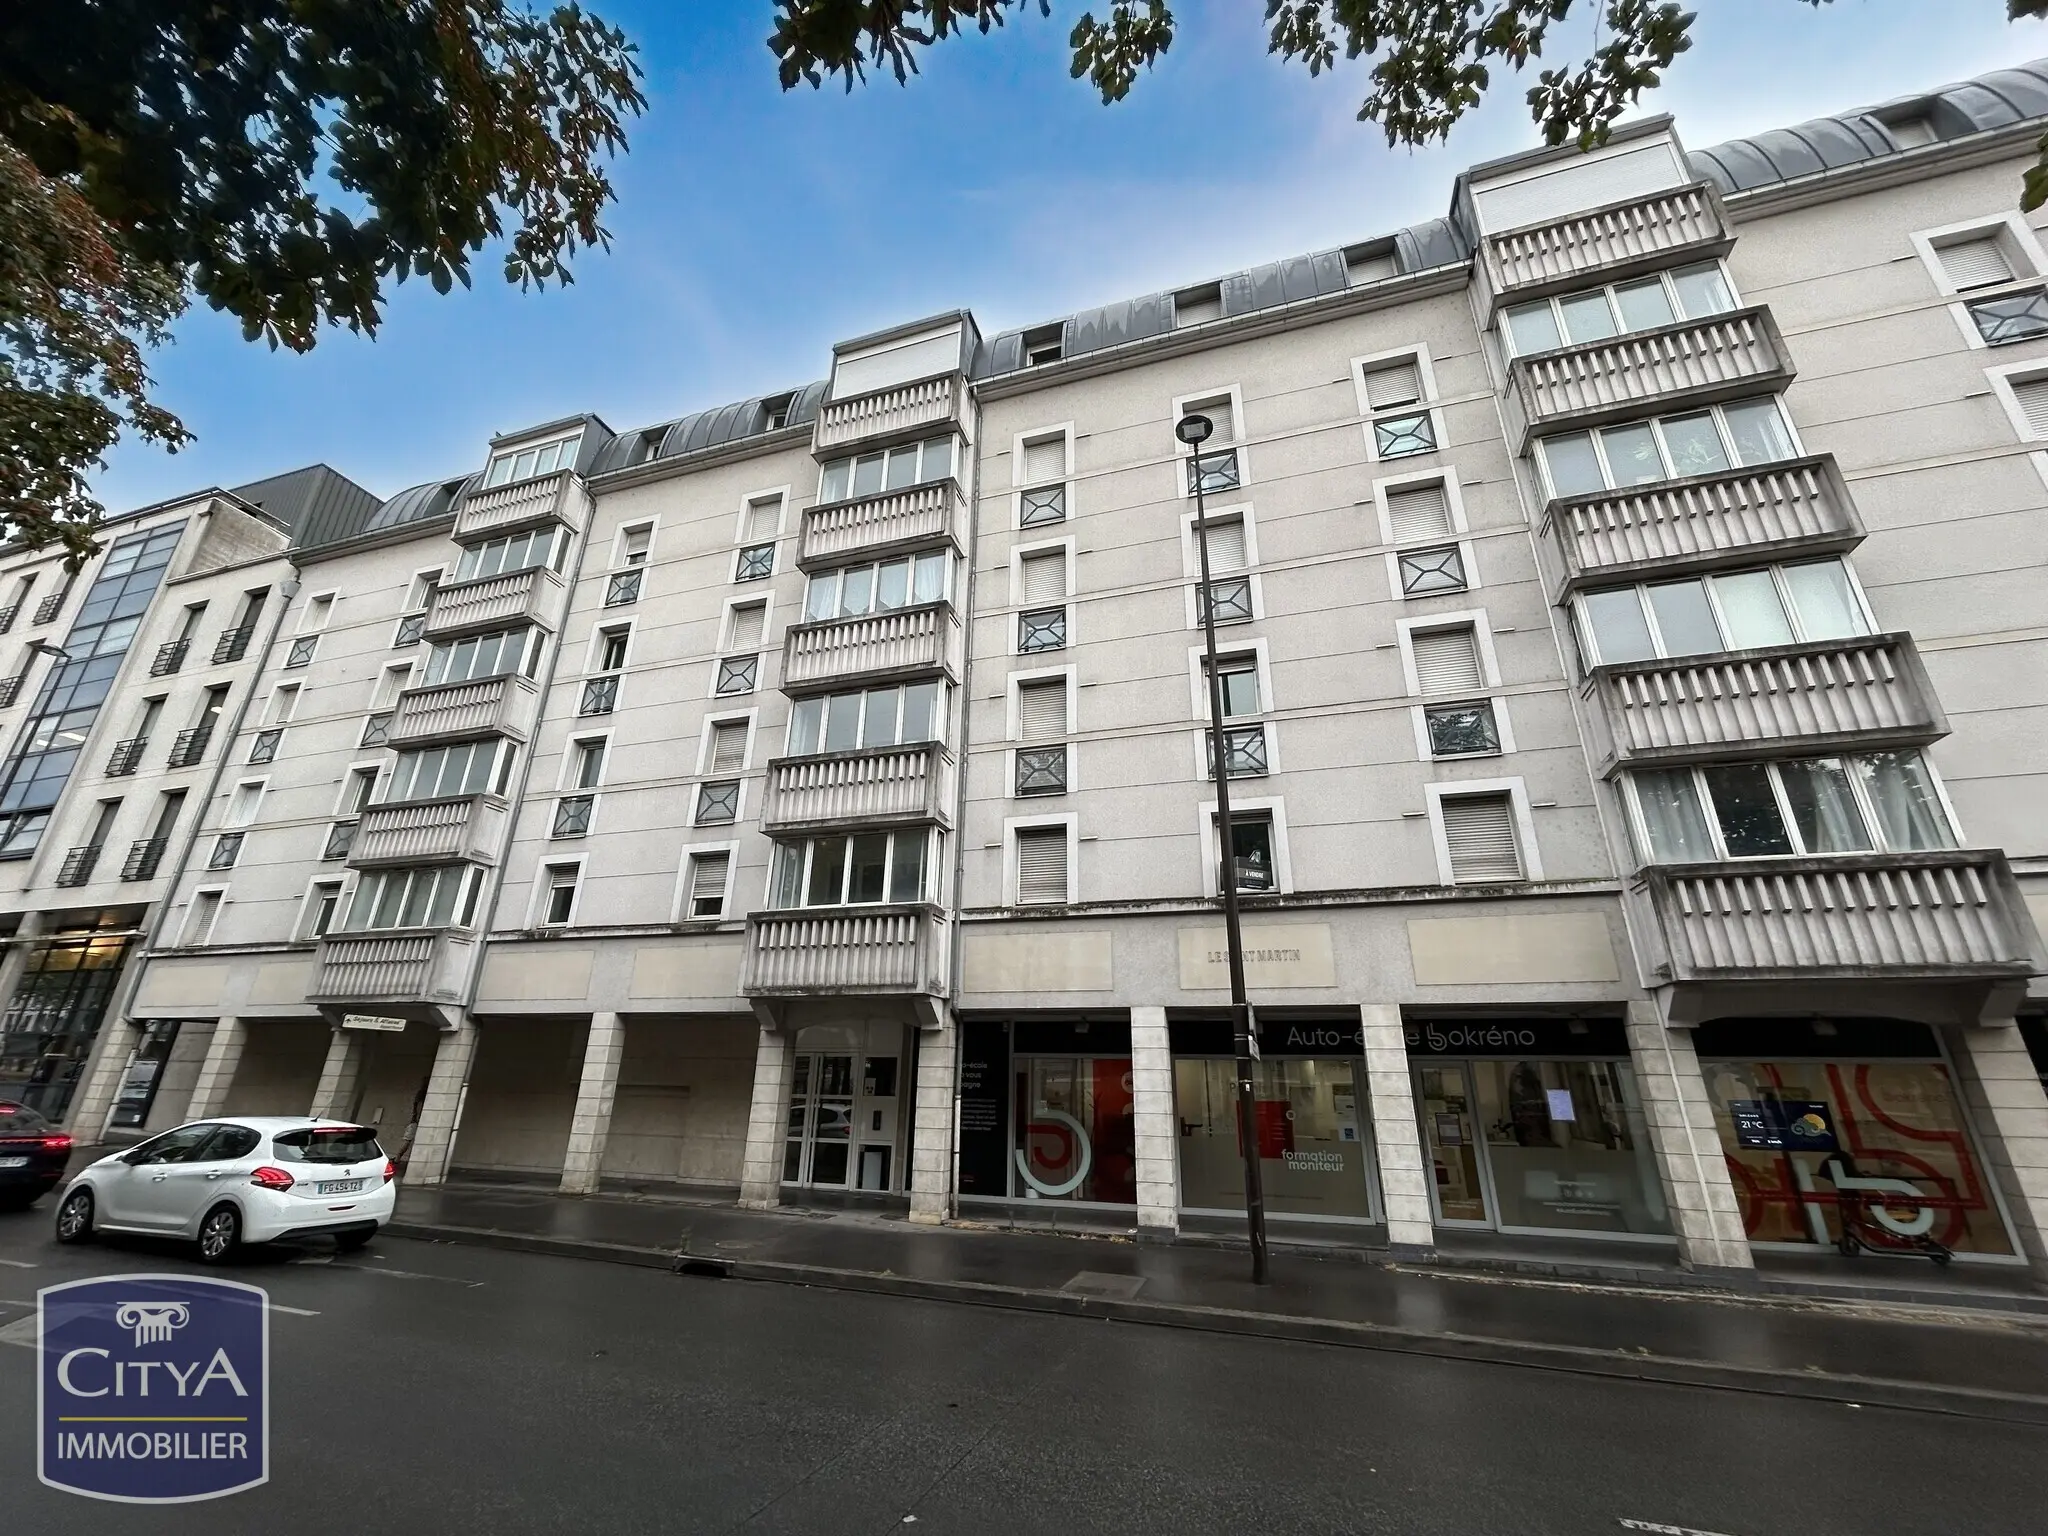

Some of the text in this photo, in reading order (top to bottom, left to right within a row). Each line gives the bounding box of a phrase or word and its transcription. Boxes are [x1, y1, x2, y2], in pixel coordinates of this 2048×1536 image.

[1208, 949, 1301, 963] LE SNT MARTIN
[1287, 1026, 1420, 1046] Auto-ée
[1281, 1149, 1343, 1161] formation
[1288, 1160, 1345, 1172] moniteur
